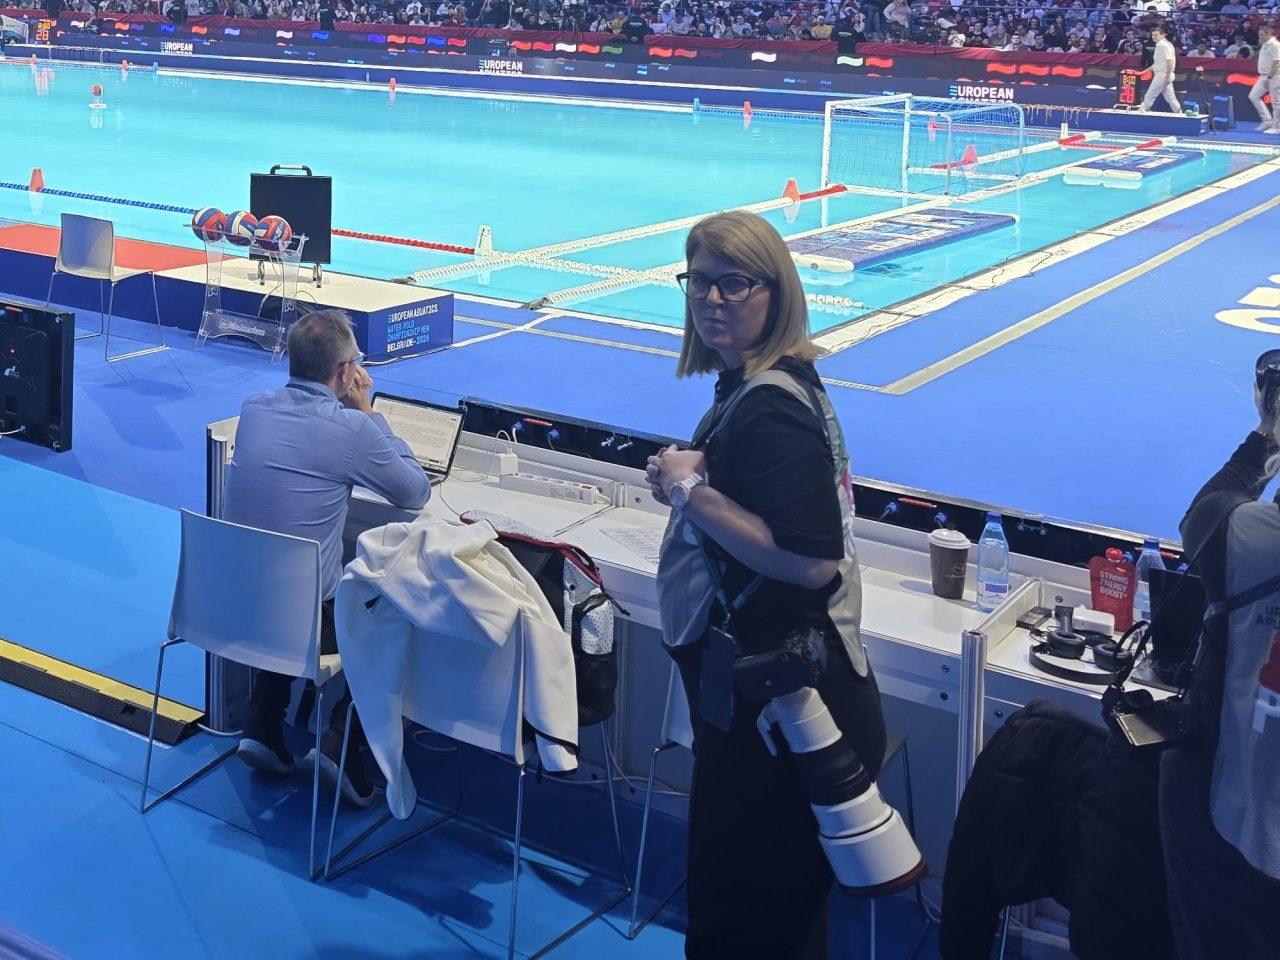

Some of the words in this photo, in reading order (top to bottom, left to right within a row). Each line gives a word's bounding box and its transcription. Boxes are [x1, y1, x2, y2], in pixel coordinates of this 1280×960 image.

[160, 41, 193, 52] EUROPEAN
[479, 60, 523, 70] EUROPEAN
[949, 85, 1014, 99] EUROPEAN
[388, 309, 414, 324] EUROPEAN
[387, 322, 403, 333] WATER
[403, 320, 415, 330] POLO
[387, 327, 420, 342] CHAMPIONSHIP
[421, 324, 430, 333] MEN
[1100, 571, 1128, 584] STRONG
[1100, 579, 1127, 592] ENERGY
